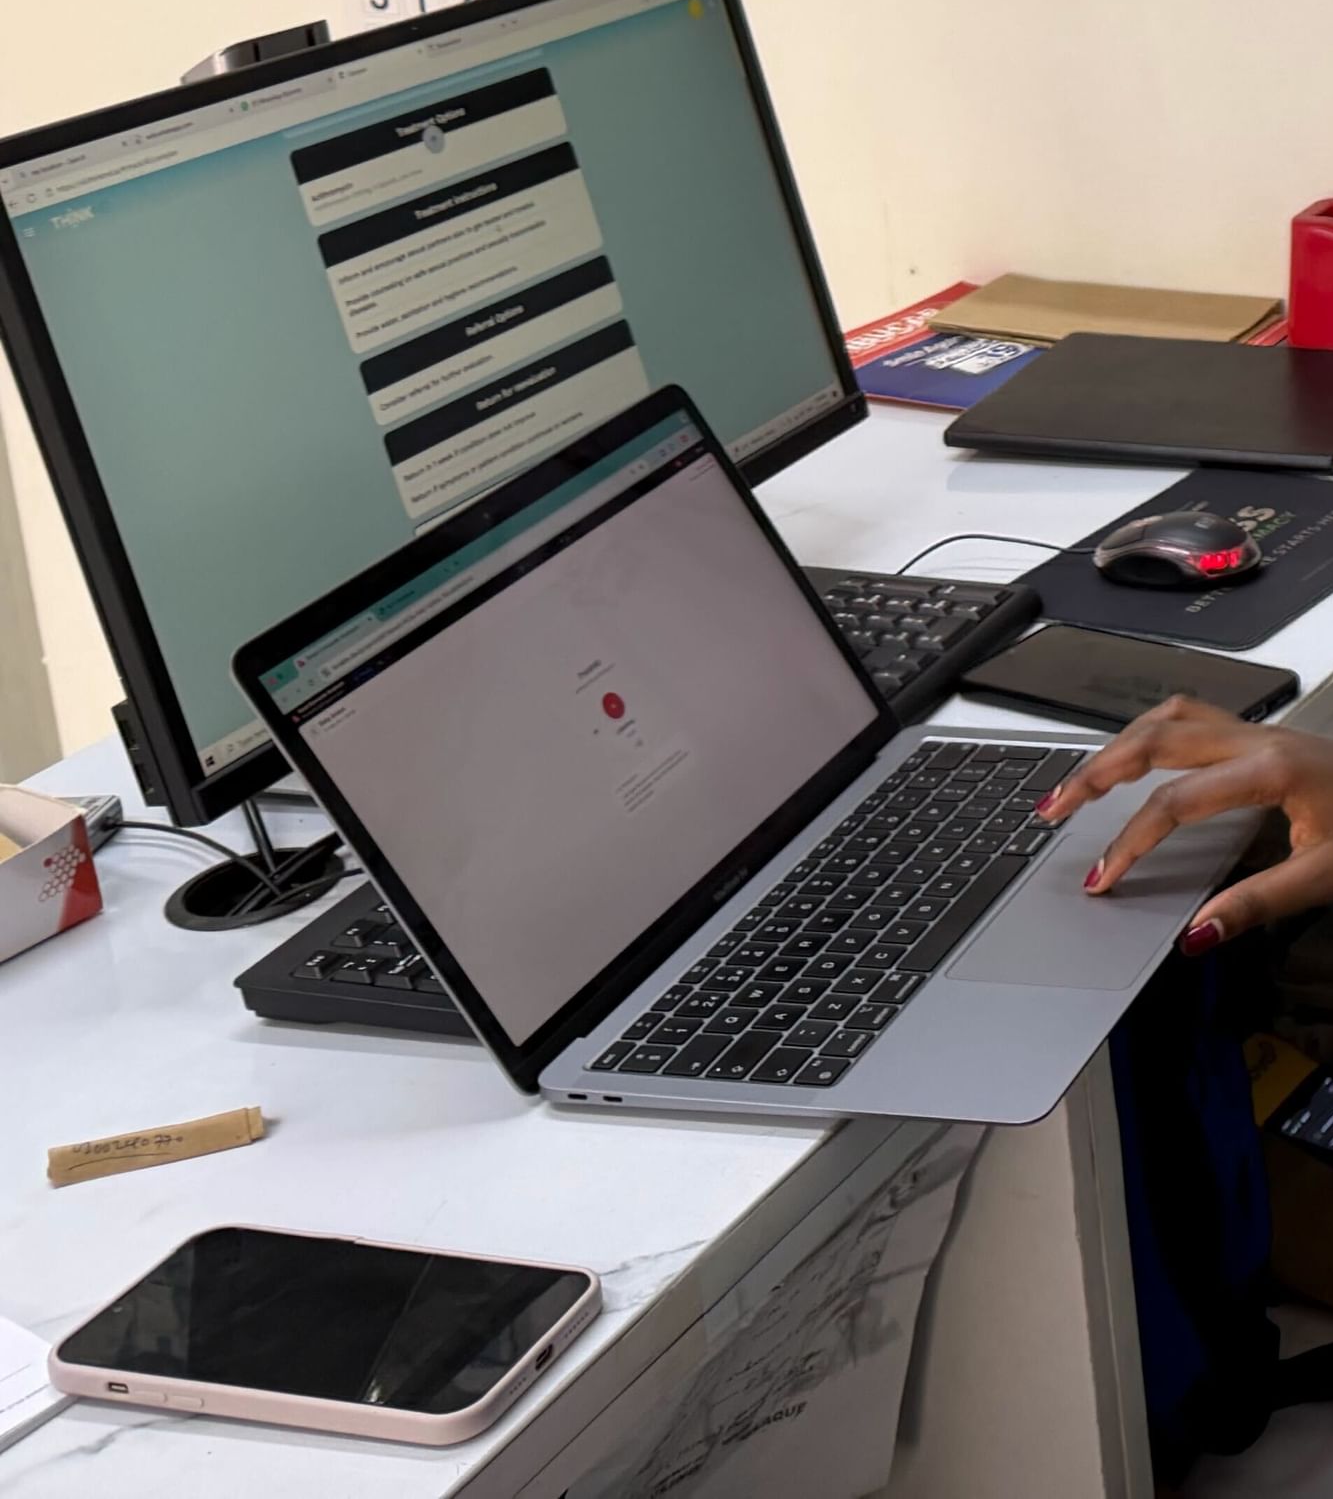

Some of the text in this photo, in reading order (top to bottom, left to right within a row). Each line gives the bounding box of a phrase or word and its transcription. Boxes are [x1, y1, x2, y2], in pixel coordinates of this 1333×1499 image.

[434, 105, 466, 124] Options
[494, 303, 525, 323] Options
[474, 386, 514, 410] Return for
